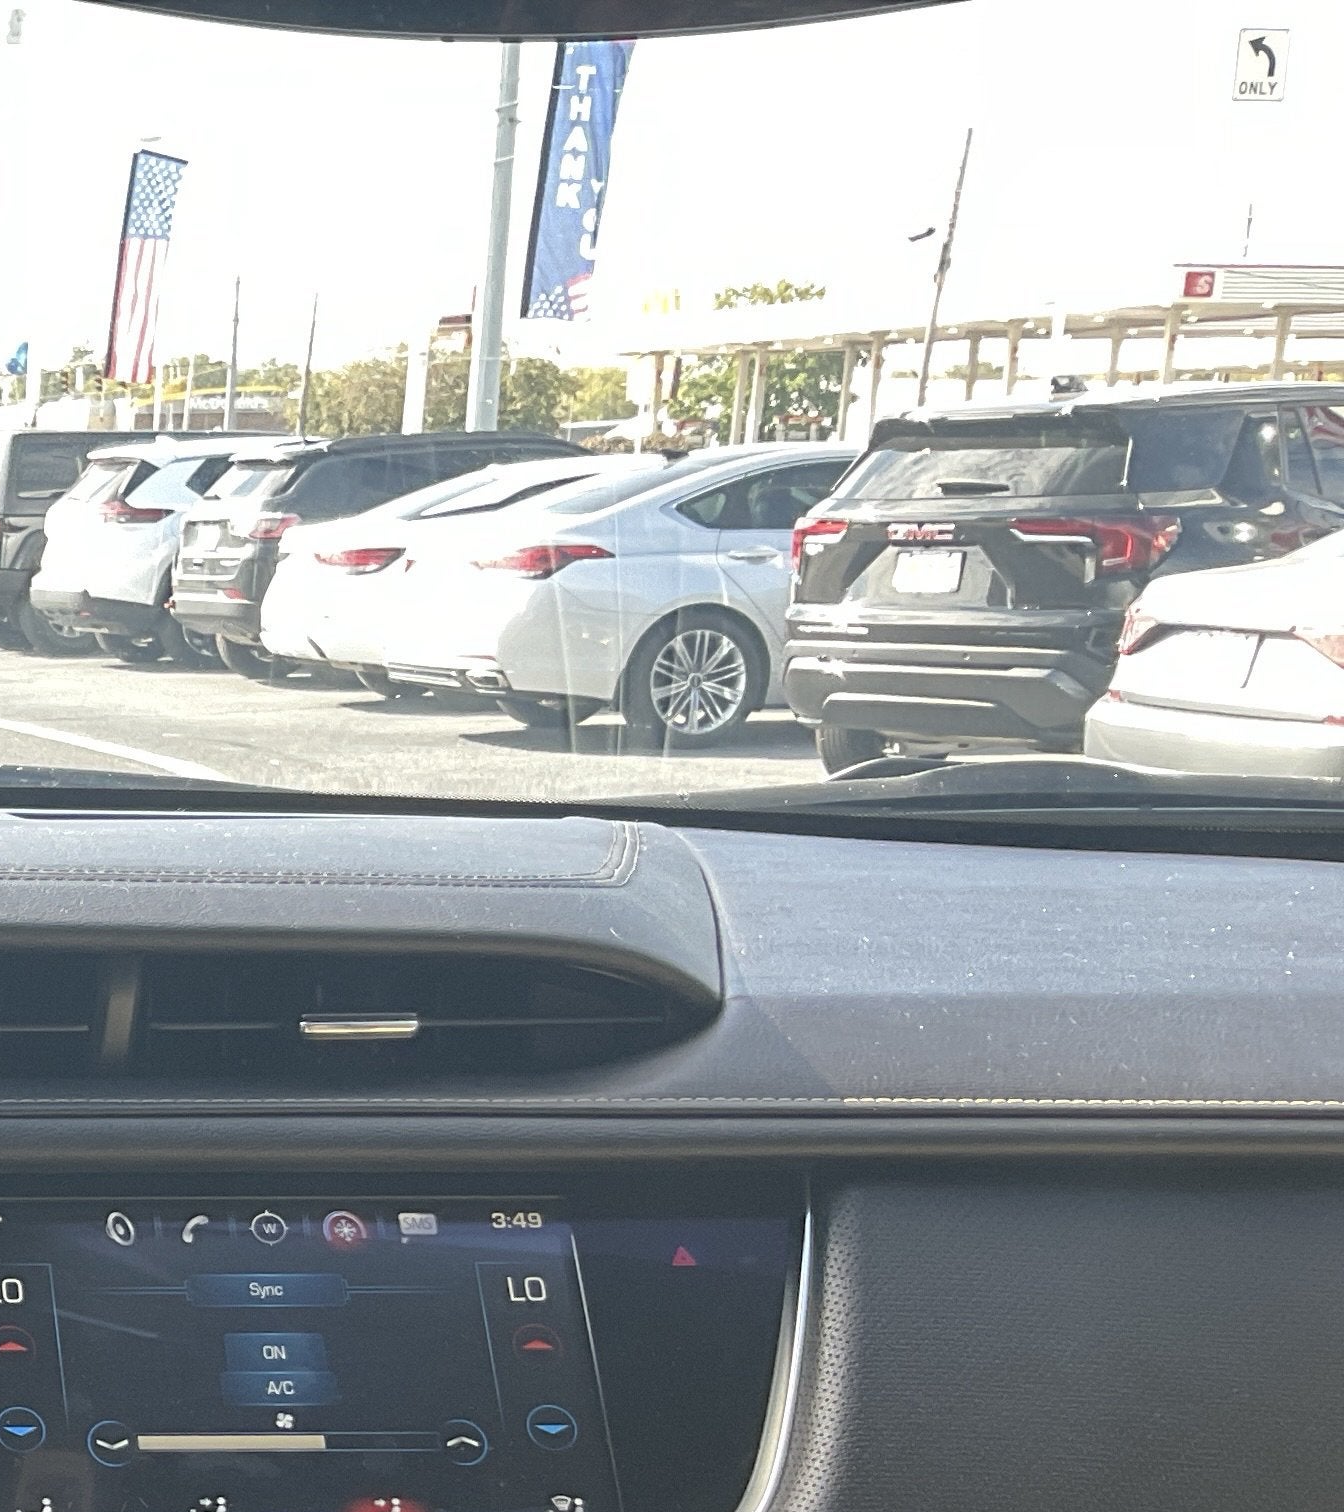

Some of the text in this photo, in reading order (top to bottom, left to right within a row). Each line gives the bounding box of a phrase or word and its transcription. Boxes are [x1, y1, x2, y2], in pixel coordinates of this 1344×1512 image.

[1238, 81, 1278, 96] ONLY
[555, 64, 597, 209] THANK
[402, 1216, 433, 1231] SMS
[490, 1212, 543, 1230] 3:49
[249, 1282, 285, 1299] Sync
[506, 1275, 548, 1303] LO
[261, 1345, 287, 1361] ON
[266, 1380, 296, 1397] A/C
